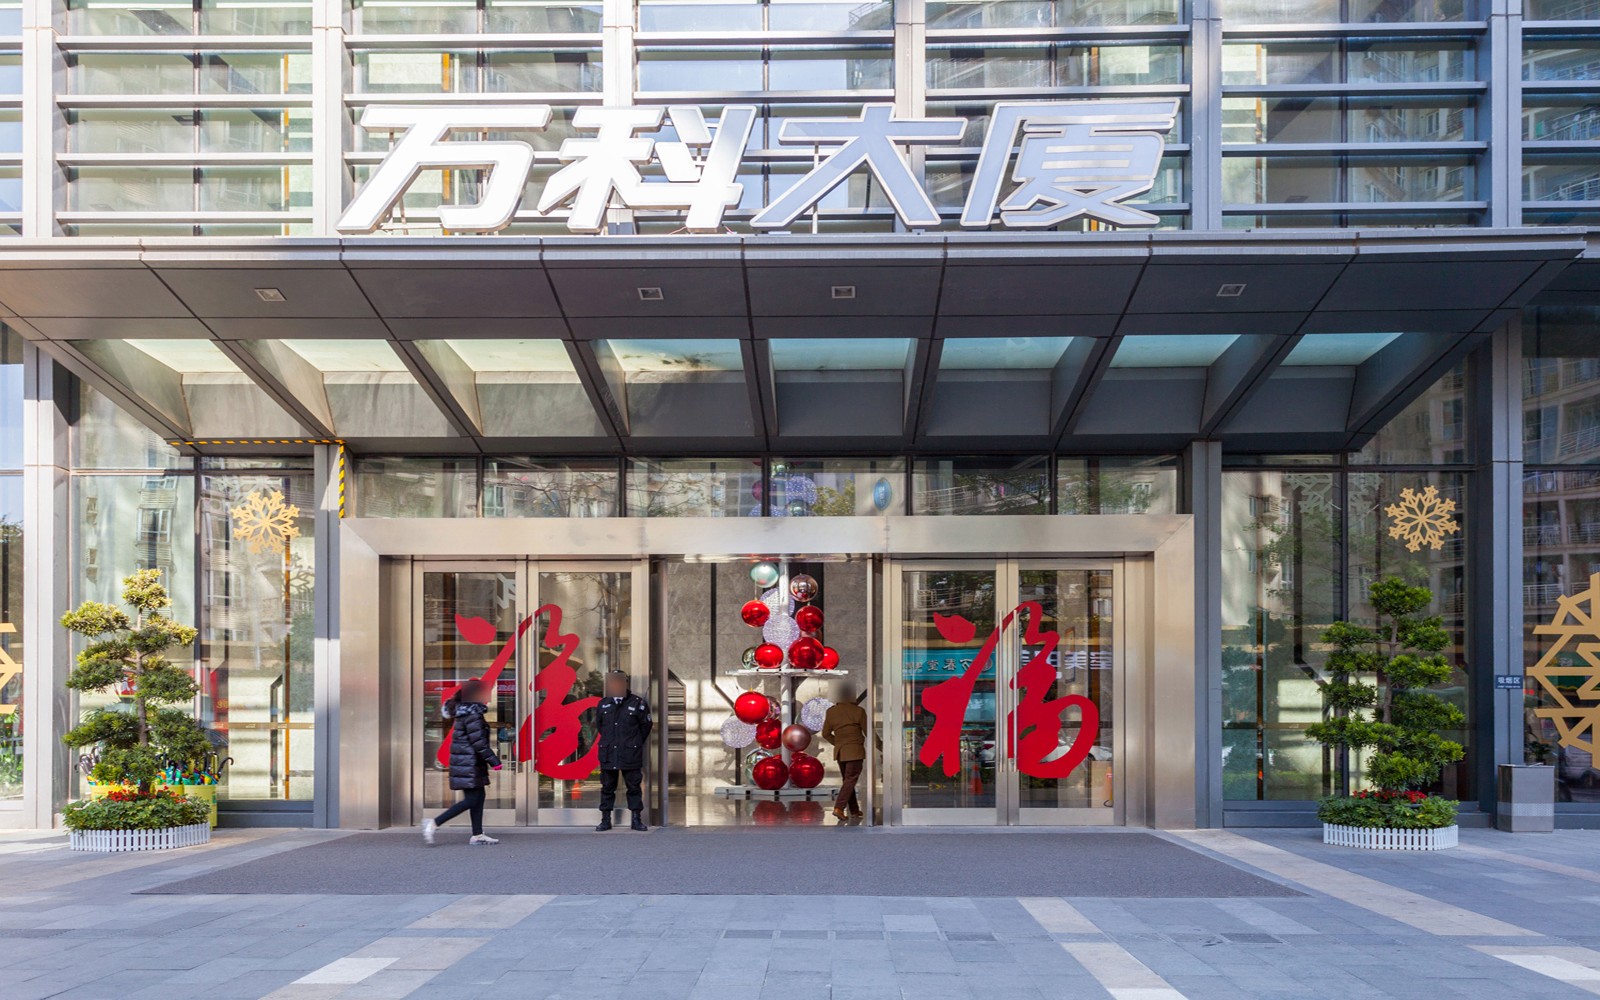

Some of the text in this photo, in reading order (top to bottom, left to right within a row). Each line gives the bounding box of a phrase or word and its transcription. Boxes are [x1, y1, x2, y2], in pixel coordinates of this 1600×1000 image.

[335, 99, 1180, 231] 万科大厦
[436, 604, 601, 780] 福
[919, 601, 1099, 778] 福
